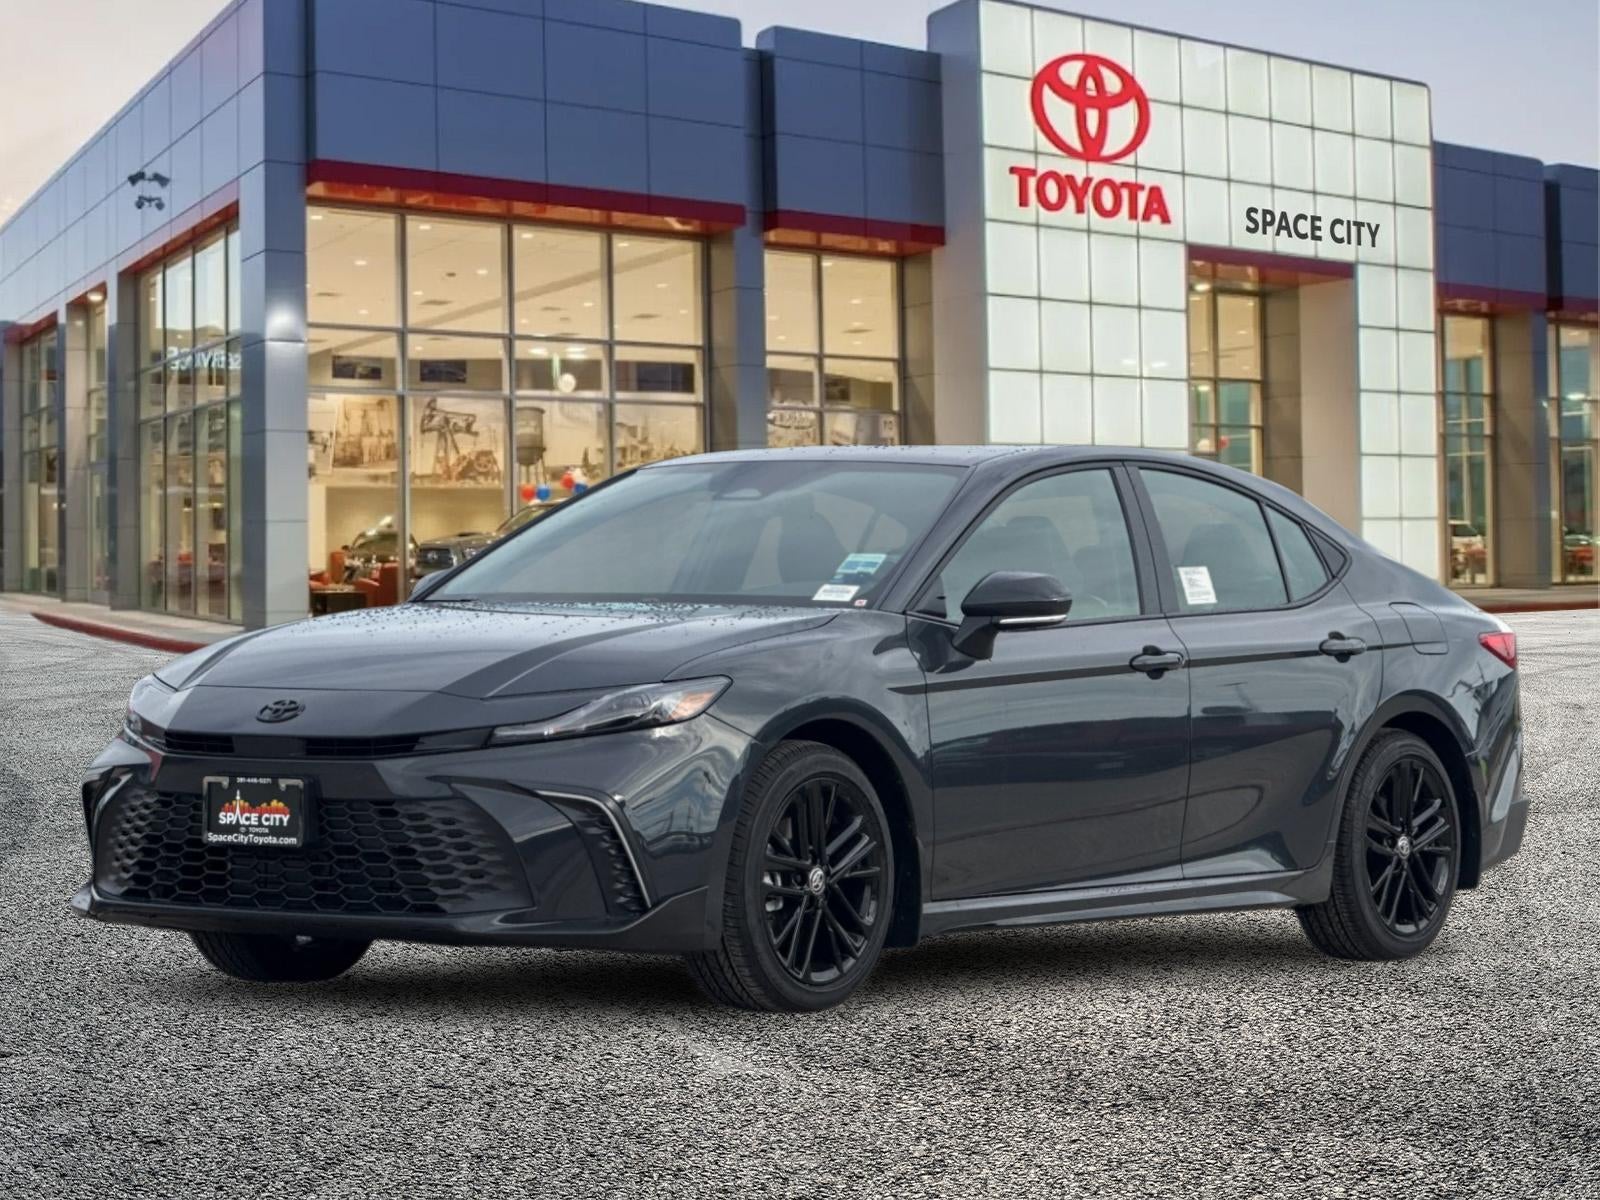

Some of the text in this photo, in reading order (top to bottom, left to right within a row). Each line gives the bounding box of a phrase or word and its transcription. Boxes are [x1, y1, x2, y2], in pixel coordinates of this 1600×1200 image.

[1009, 166, 1171, 224] TOYOTA
[1245, 206, 1381, 248] SPACE CITY
[218, 812, 290, 826] SPACE CITY
[207, 832, 297, 845] SpaceCityToyota.com
